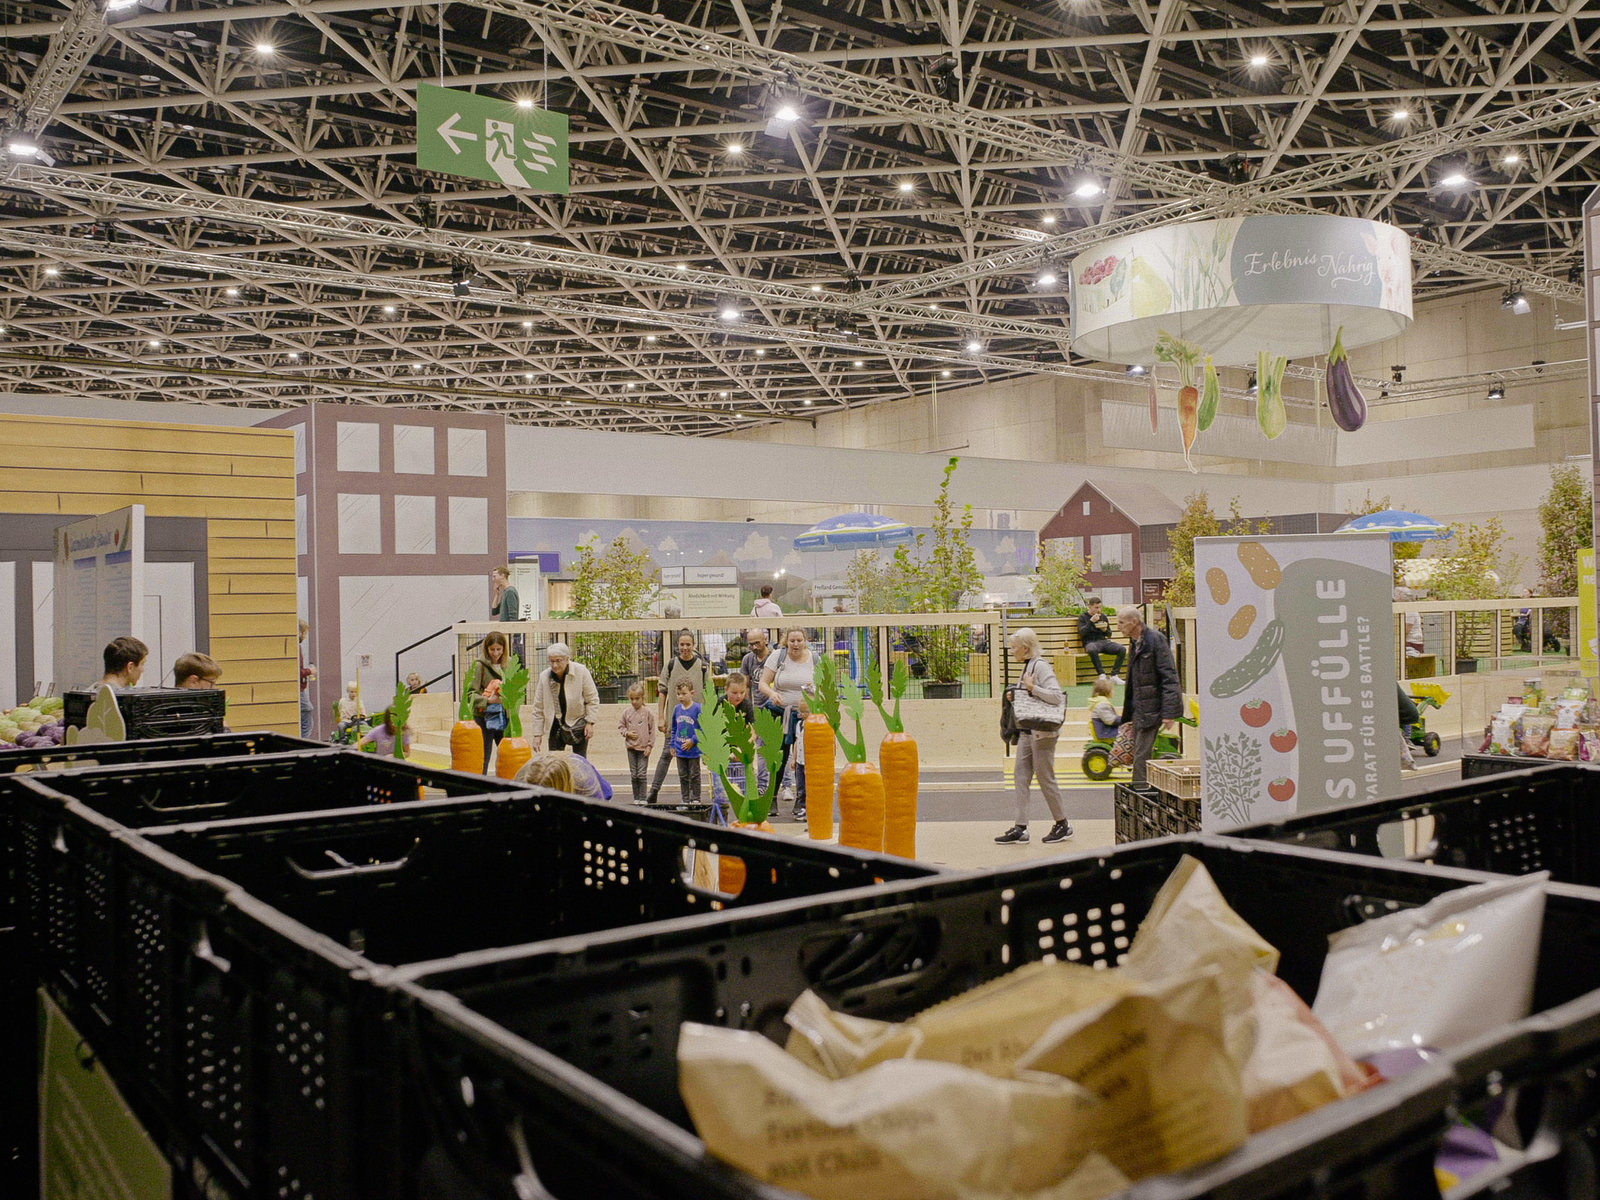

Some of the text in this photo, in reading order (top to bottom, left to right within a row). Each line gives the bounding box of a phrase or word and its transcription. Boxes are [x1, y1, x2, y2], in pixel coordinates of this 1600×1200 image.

[1244, 249, 1376, 289] Erlebnis Nahrig
[1357, 616, 1372, 684] BATTLE?
[1311, 578, 1355, 764] UFFÜLLE
[1361, 689, 1374, 709] ES
[1360, 714, 1376, 746] FÜR
